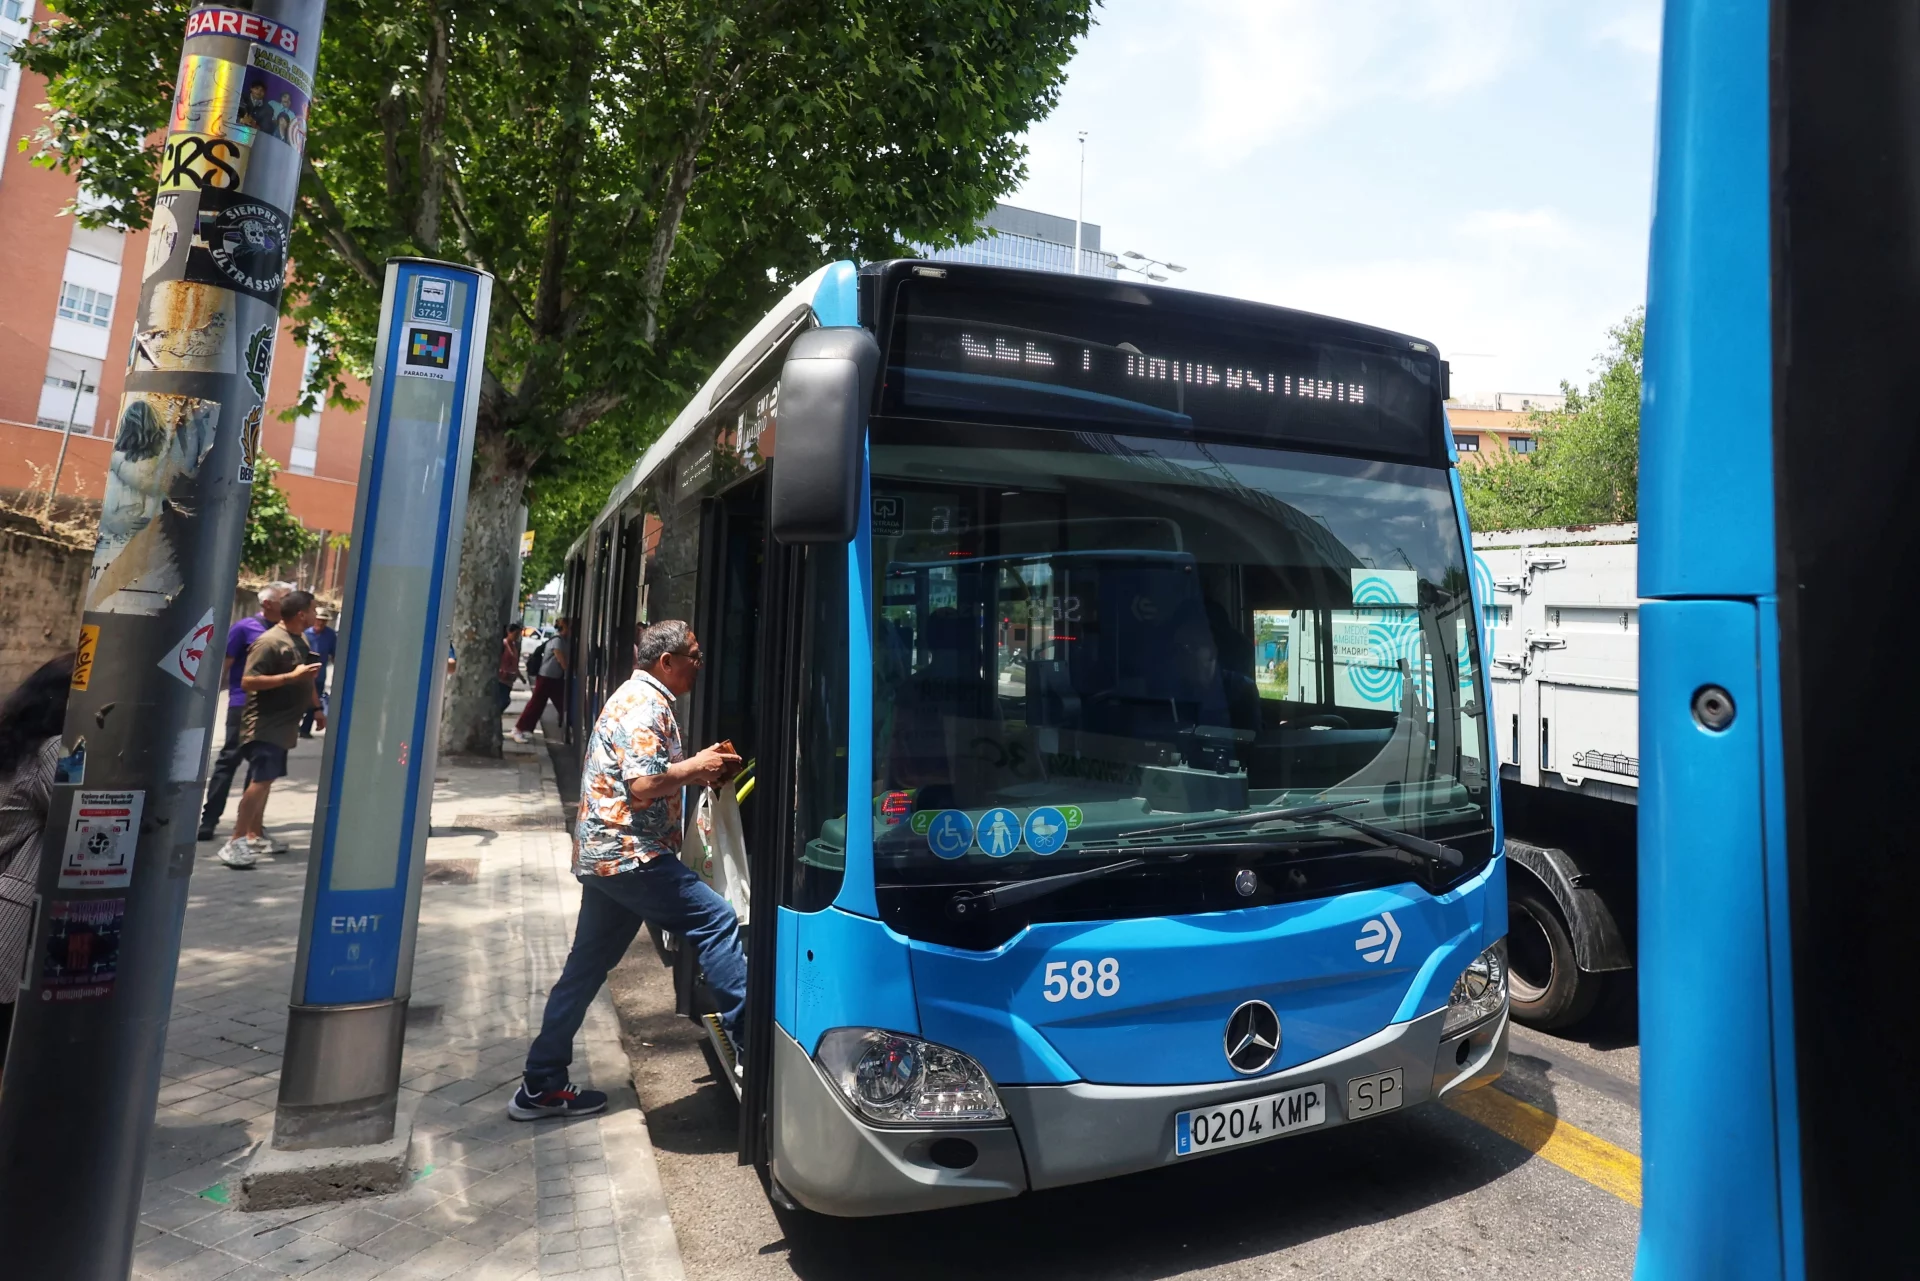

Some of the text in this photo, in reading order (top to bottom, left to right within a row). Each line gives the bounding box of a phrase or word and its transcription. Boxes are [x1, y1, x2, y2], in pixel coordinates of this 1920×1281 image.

[226, 206, 278, 224] SIEMPRE
[212, 248, 281, 291] ULTRASSUR
[418, 308, 443, 319] 3742
[871, 520, 900, 528] NTRADA
[1344, 625, 1368, 635] MEDIO
[1334, 634, 1368, 646] AMBIENTE
[1342, 646, 1369, 656] MADRID
[917, 814, 926, 828] 2
[1069, 809, 1077, 822] 2
[330, 914, 383, 934] EMT
[1042, 957, 1121, 1002] 588
[1356, 1075, 1395, 1111] SP
[1181, 1091, 1317, 1147] E 0204 KMP
